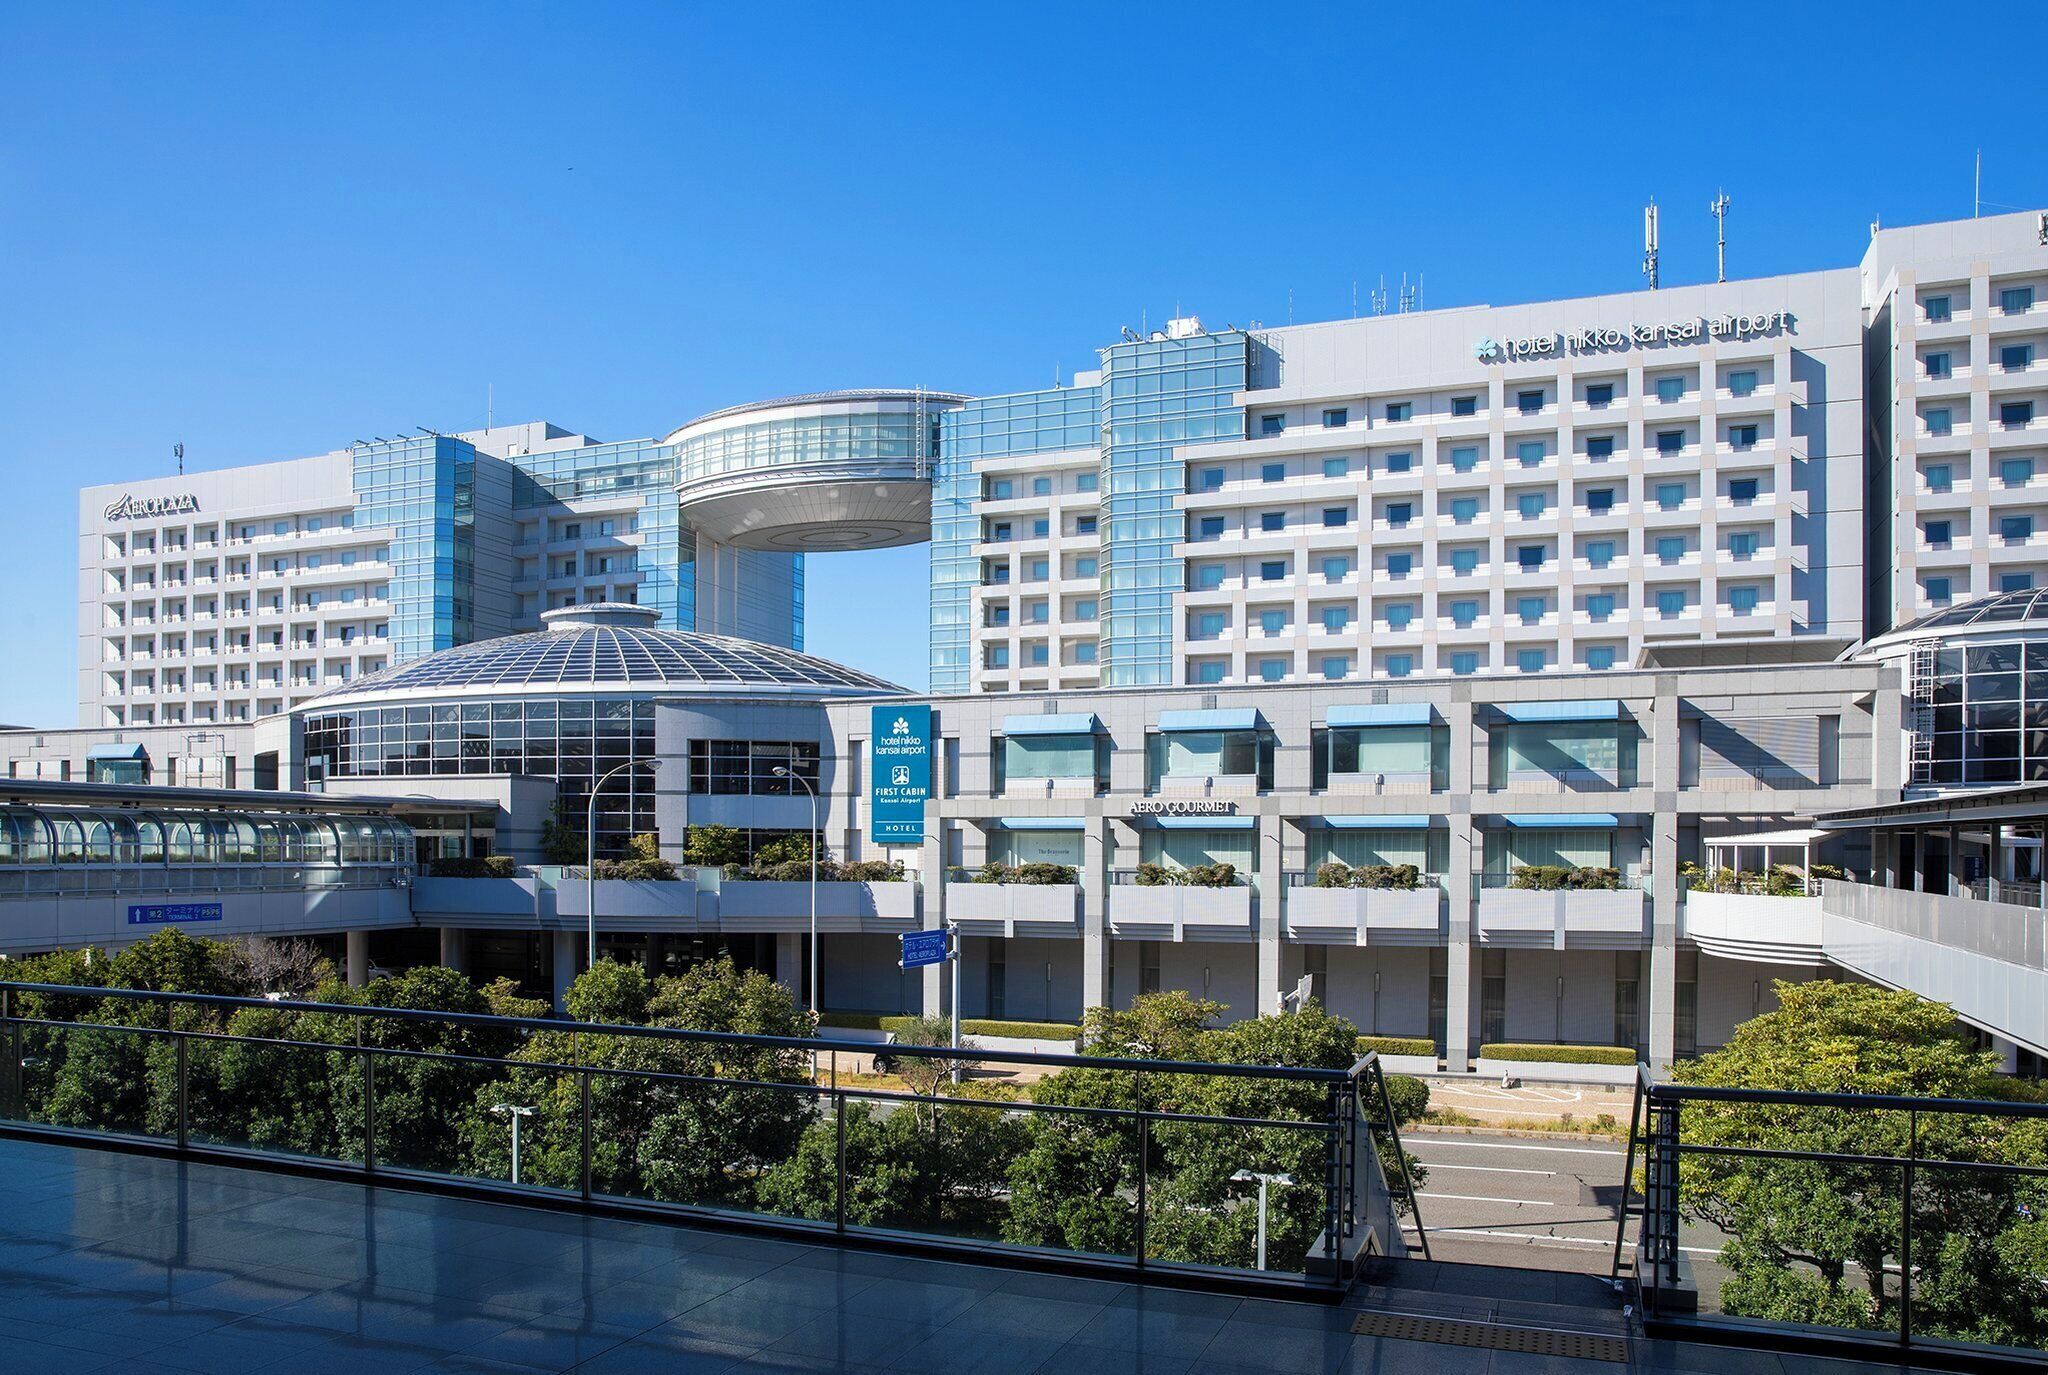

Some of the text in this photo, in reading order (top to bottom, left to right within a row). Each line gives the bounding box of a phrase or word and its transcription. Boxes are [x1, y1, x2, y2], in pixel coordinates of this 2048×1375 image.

[1502, 308, 1788, 357] hotel nikko kansai airport
[122, 493, 195, 516] AEROPLAZA
[881, 736, 921, 745] hotel nikko
[876, 745, 926, 756] kansai airport
[875, 787, 926, 796] FIRST CABIN
[1129, 801, 1231, 813] AERO GOURMET
